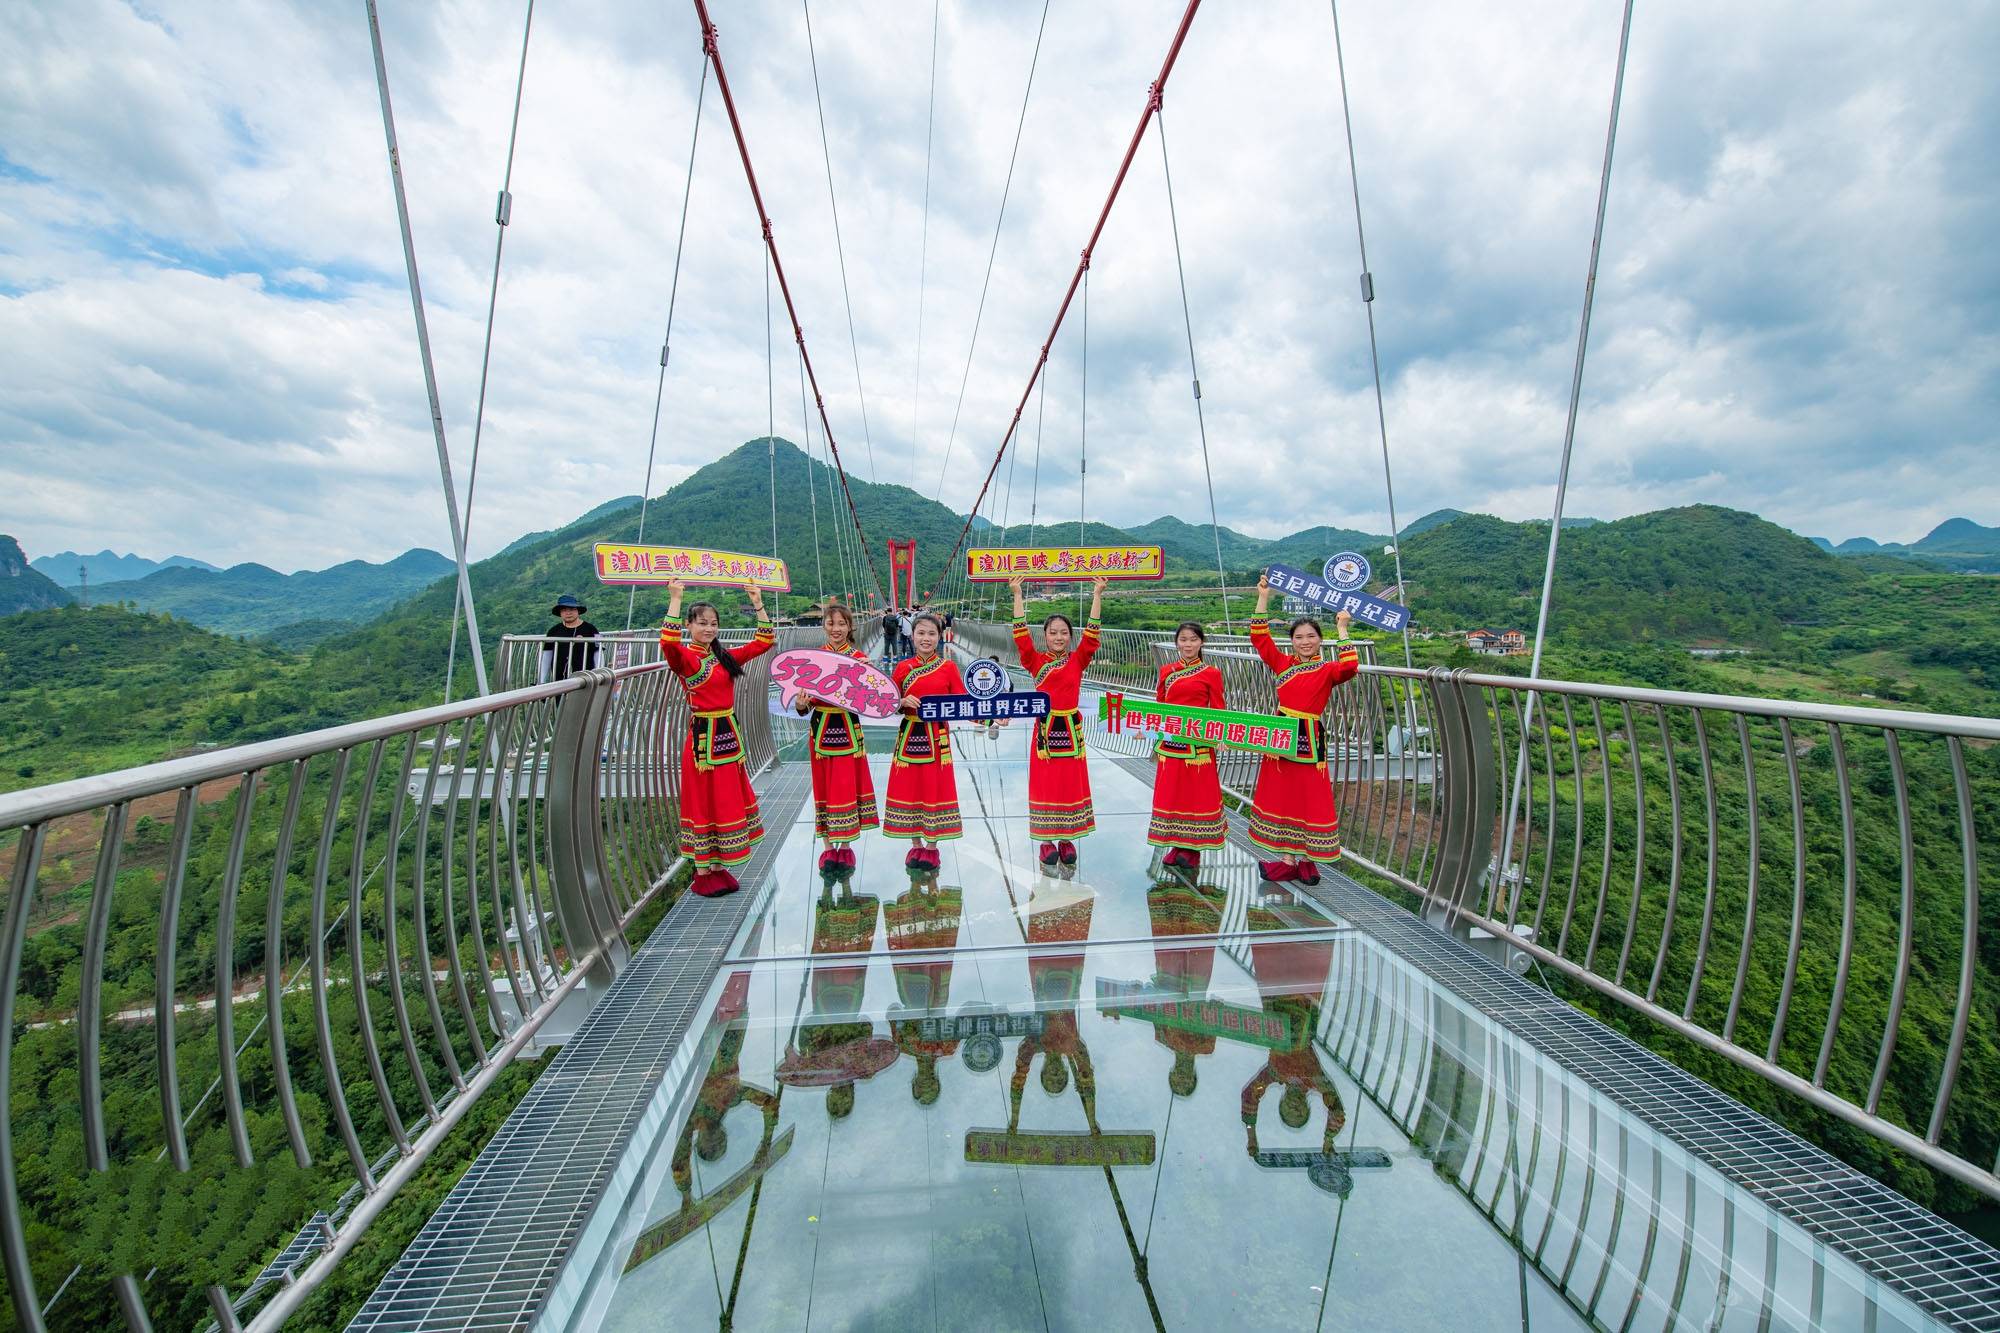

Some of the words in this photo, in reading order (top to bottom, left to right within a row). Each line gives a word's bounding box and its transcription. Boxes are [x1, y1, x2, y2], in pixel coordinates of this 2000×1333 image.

[611, 550, 692, 575] 湟川三峡
[979, 553, 1049, 573] 湟川三峡
[1336, 555, 1366, 570] GUINNESS
[1337, 574, 1365, 588] RECORDS
[1268, 569, 1402, 629] 吉尼斯世界纪录
[970, 663, 998, 674] GUINNESS
[921, 698, 1047, 719] 吉尼斯世界纪录
[1125, 711, 1293, 750] 世界最长的玻璃桥
